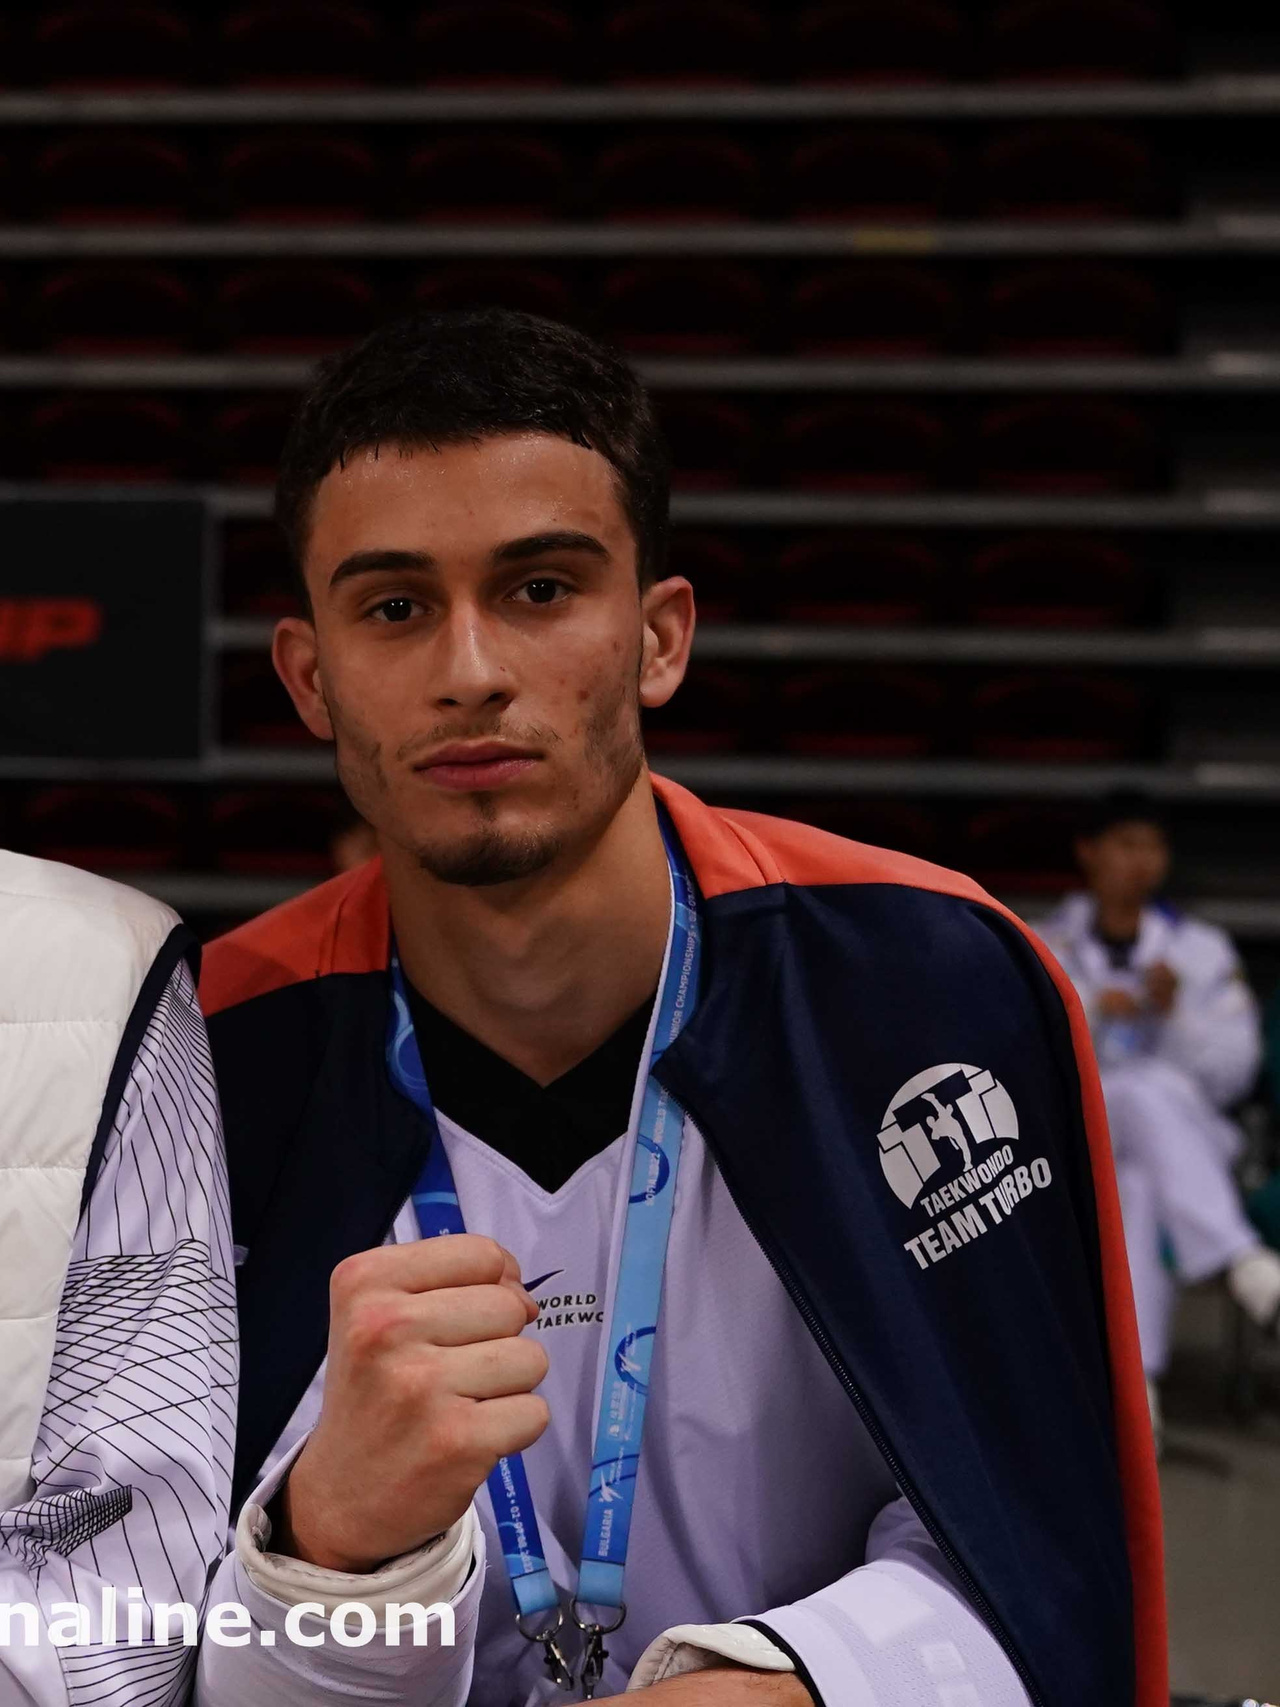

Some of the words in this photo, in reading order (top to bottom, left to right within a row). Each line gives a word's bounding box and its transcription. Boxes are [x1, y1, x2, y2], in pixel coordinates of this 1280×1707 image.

[675, 930, 697, 1008] CHAMPIONSHIPS
[903, 1203, 988, 1270] TEAM
[978, 1157, 1053, 1225] TURBO
[920, 1144, 1014, 1218] TAEKWONDO
[536, 1294, 597, 1311] WORLD
[536, 1311, 604, 1330] TAEKWO
